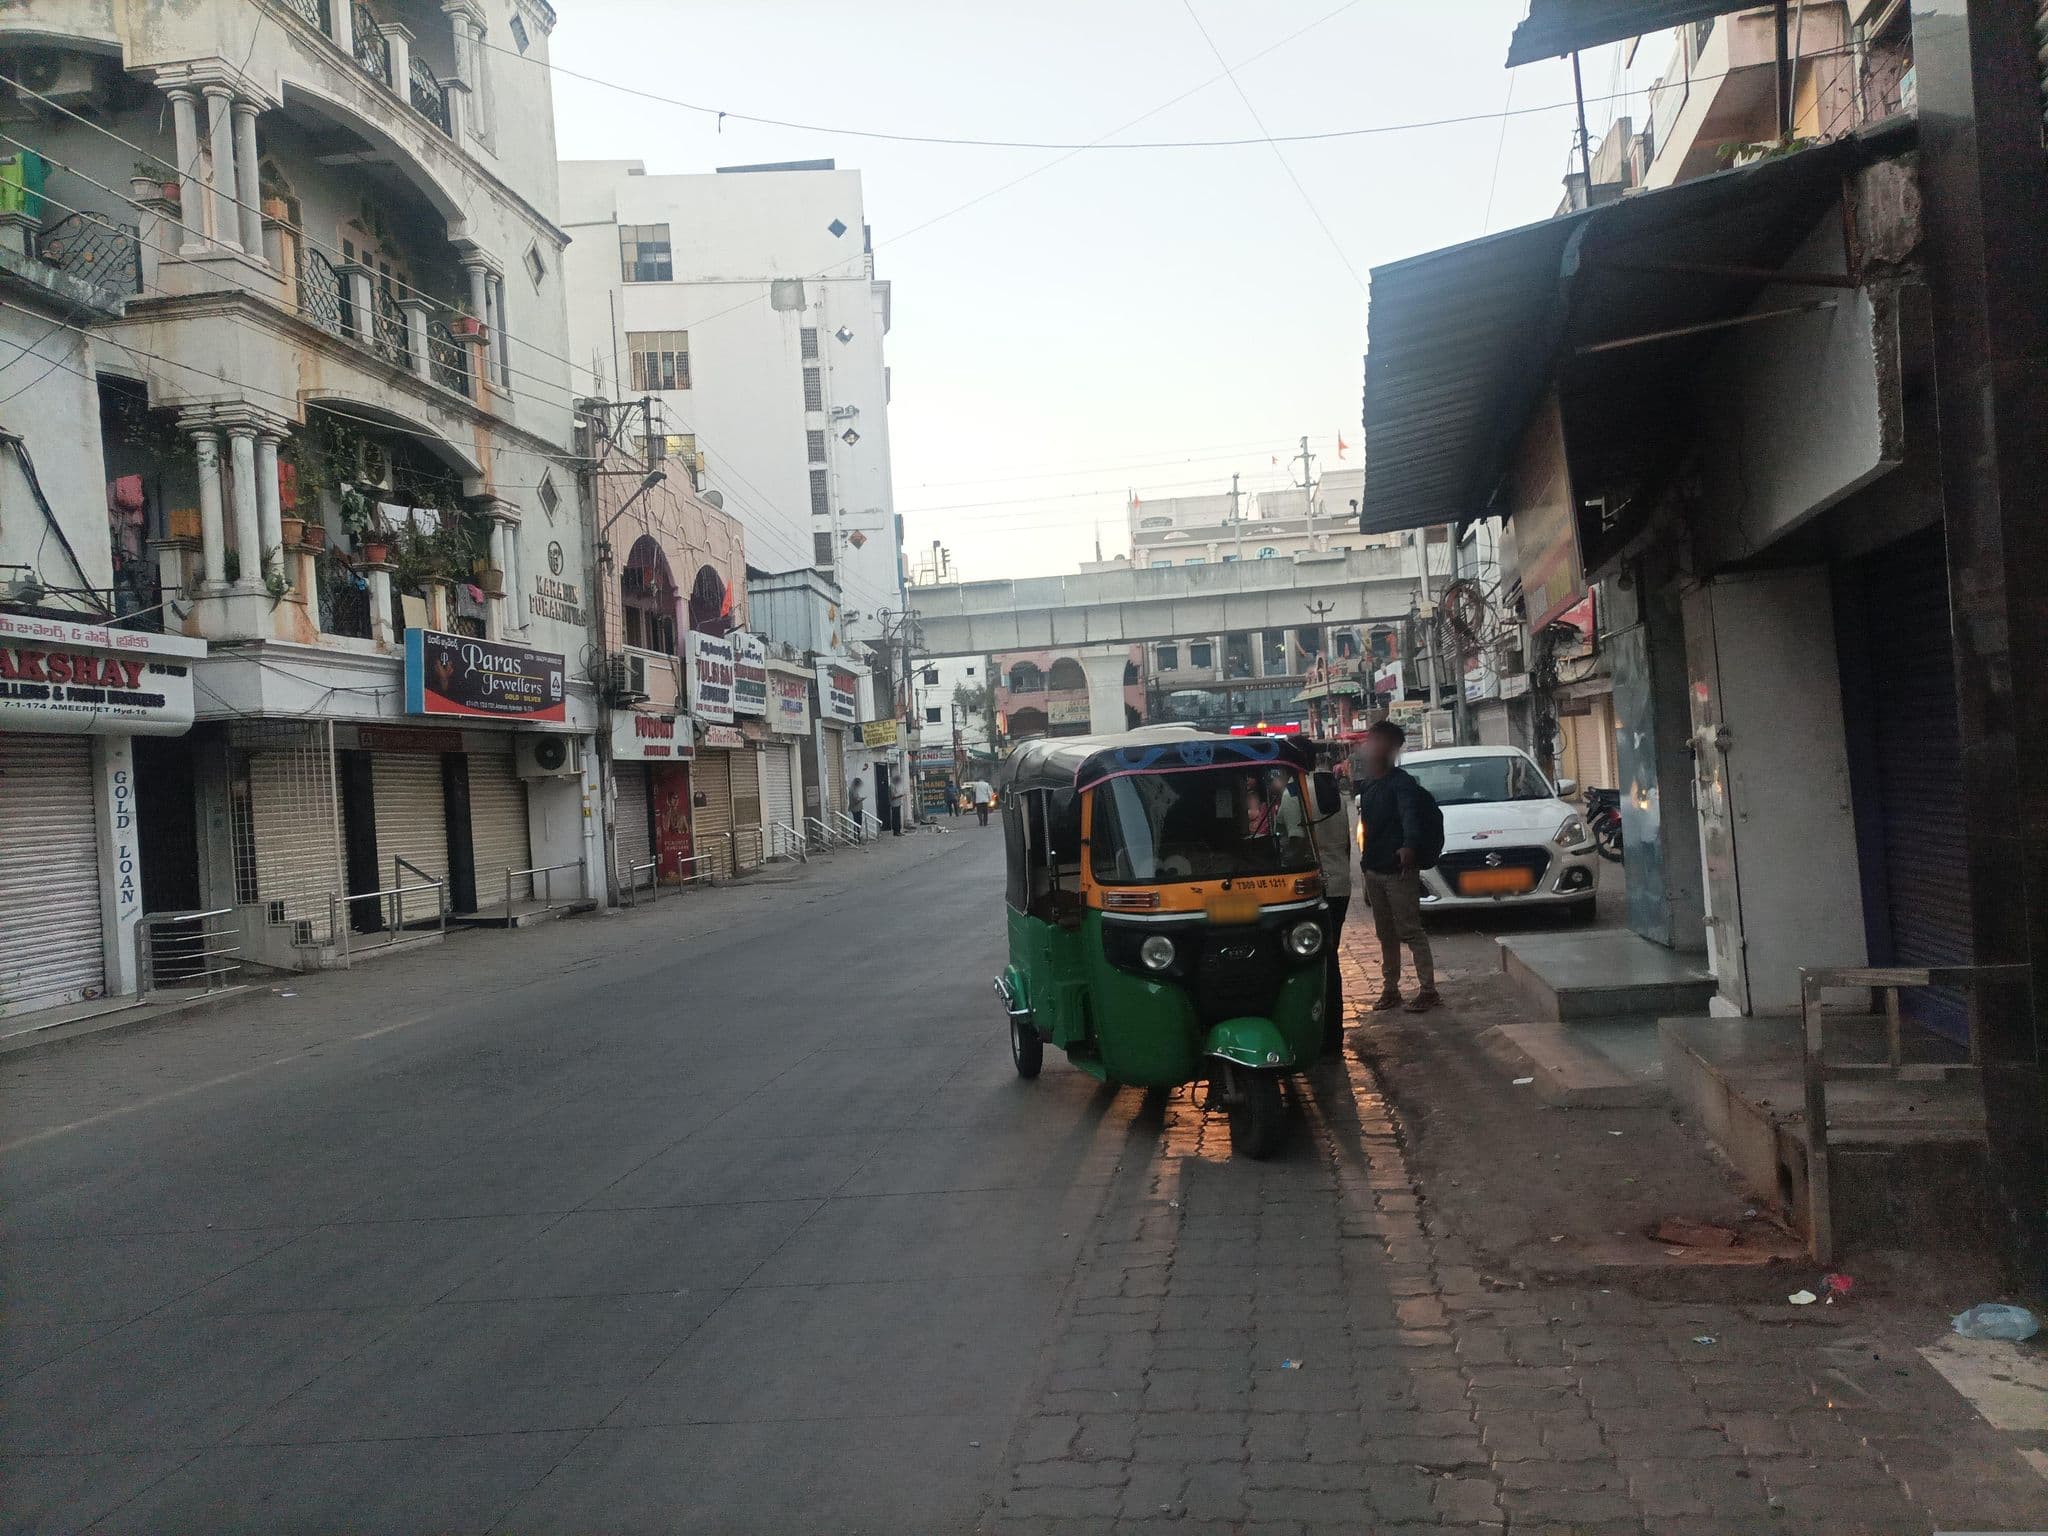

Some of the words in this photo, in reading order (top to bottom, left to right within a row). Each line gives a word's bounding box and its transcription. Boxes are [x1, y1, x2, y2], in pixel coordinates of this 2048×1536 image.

[461, 643, 522, 680] Paras
[482, 673, 543, 696] Jewellers
[49, 703, 111, 714] AMEERPET
[113, 770, 131, 830] GOLD
[118, 845, 136, 905] LOAN
